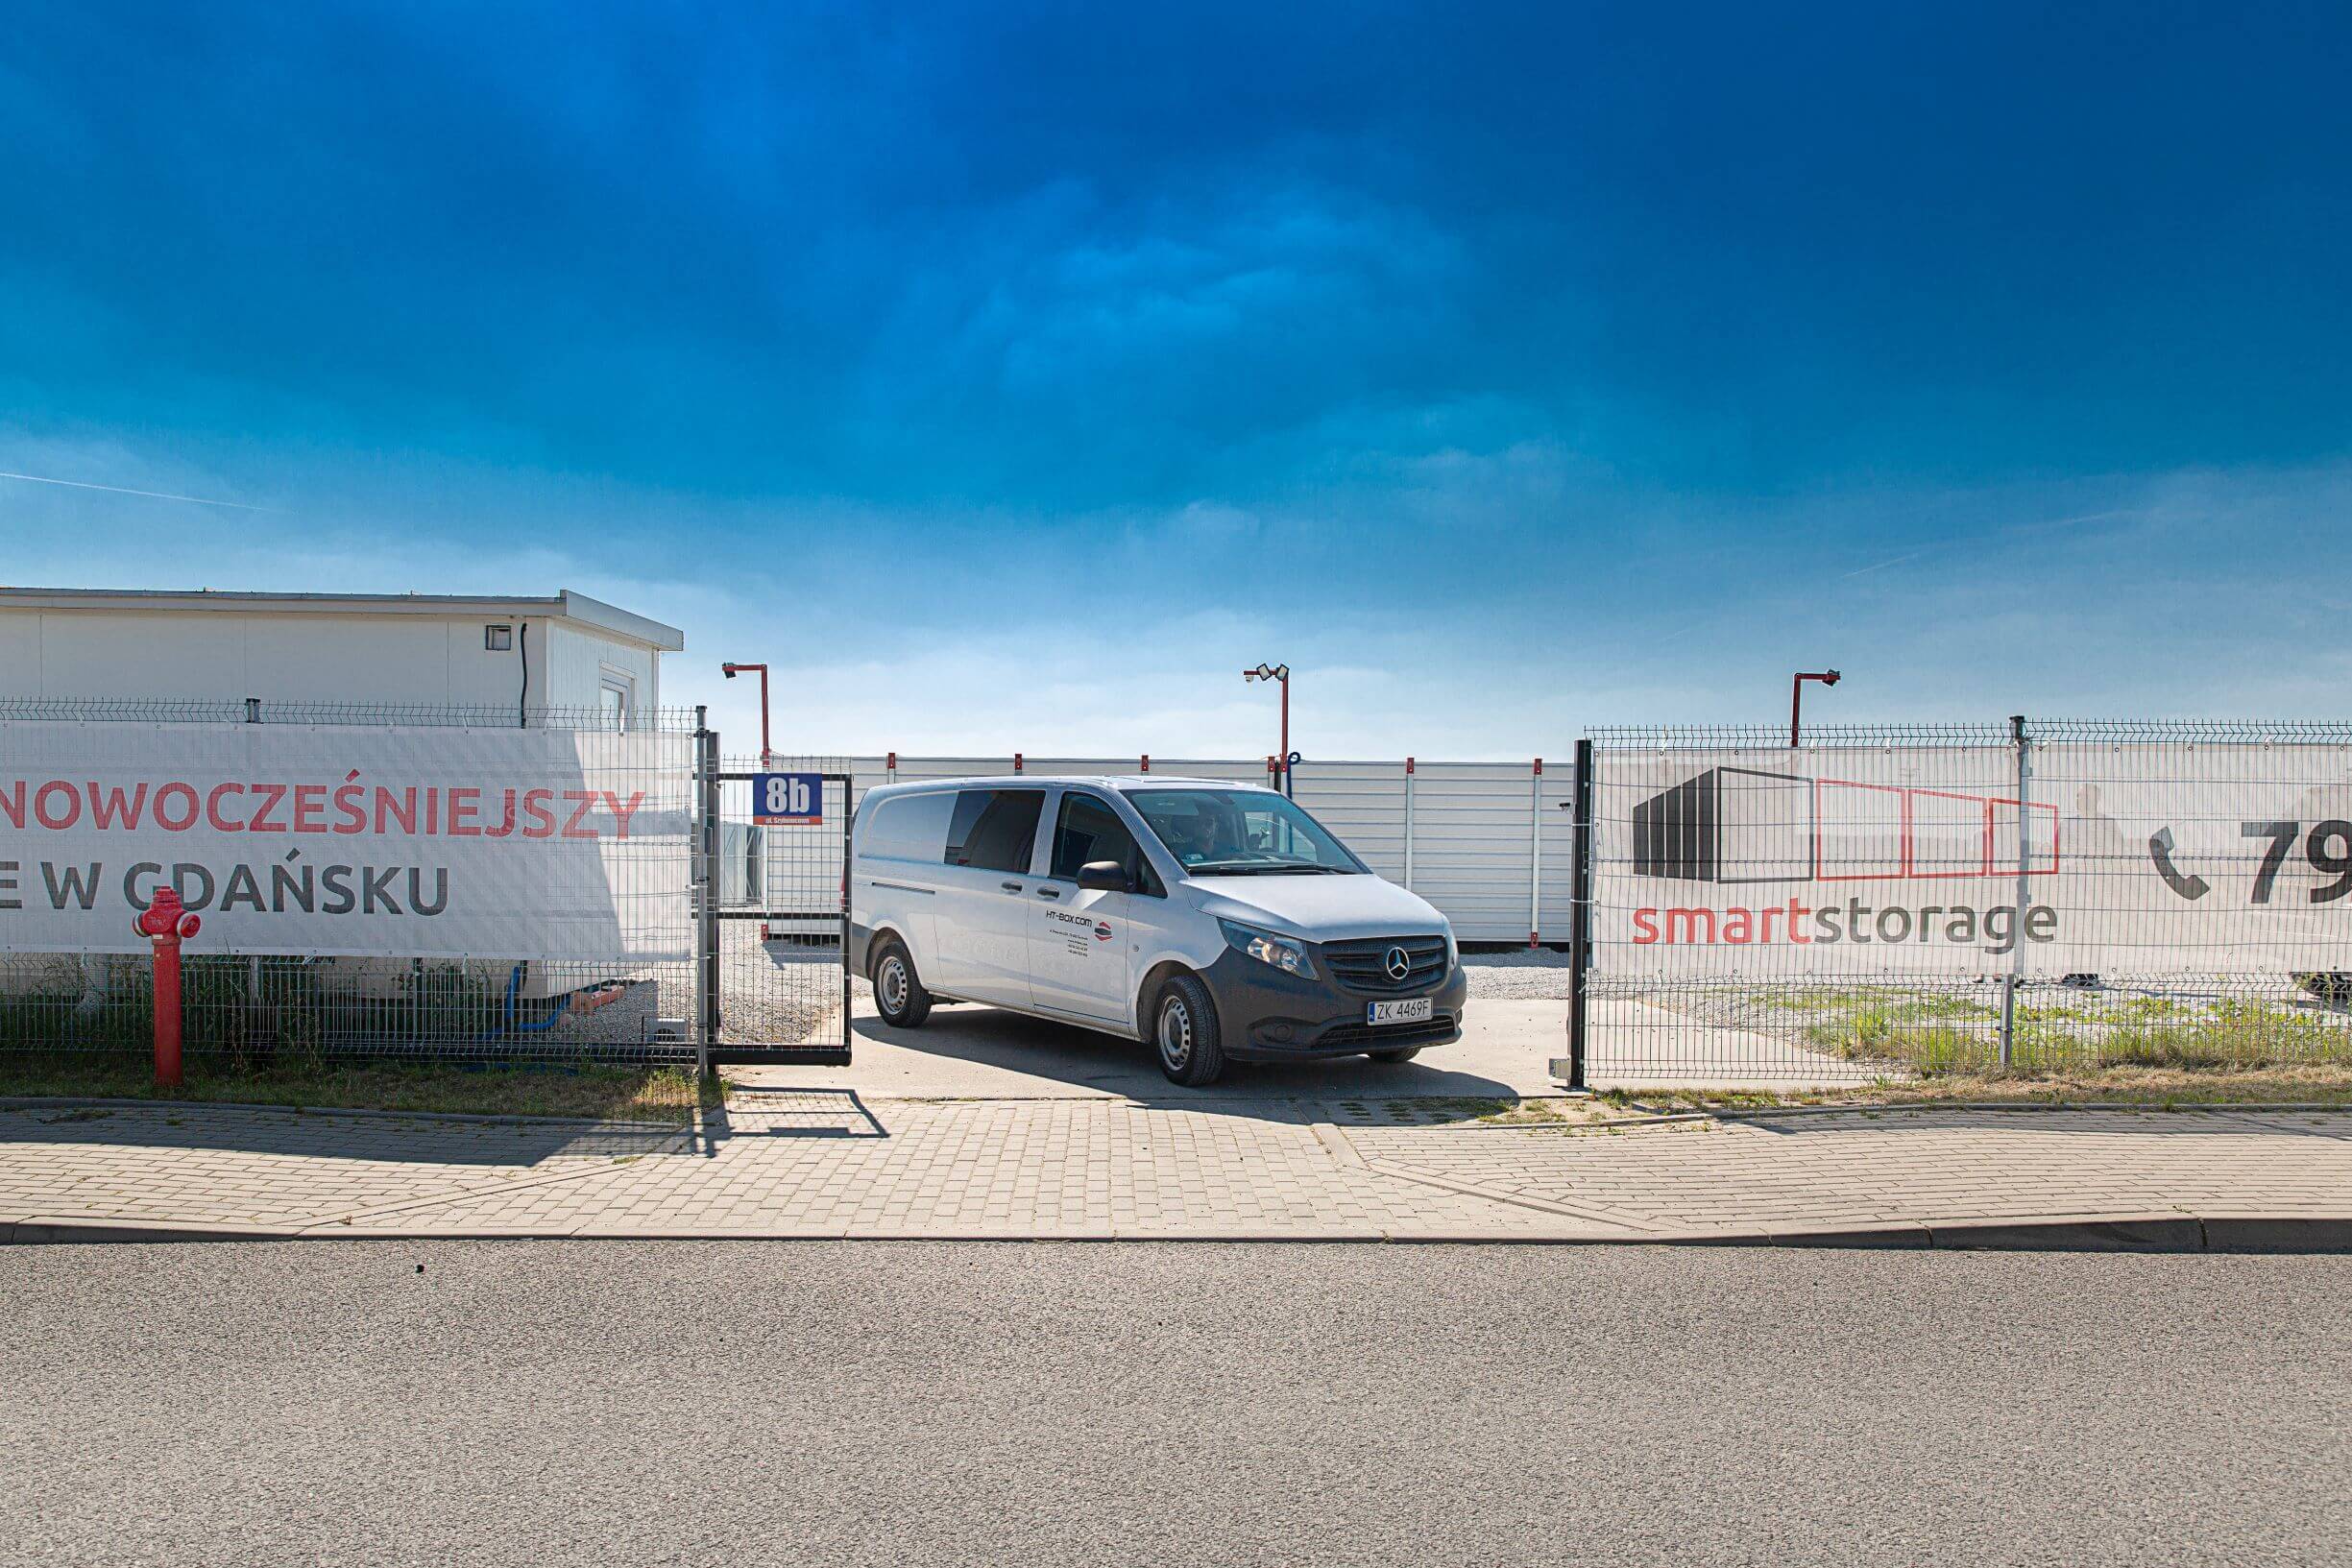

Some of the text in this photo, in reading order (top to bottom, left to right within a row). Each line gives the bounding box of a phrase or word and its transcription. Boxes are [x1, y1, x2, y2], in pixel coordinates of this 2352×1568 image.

[0, 768, 646, 840] NOWOCZEŚNIEJSZY
[766, 777, 810, 813] 8b
[40, 861, 103, 910] W
[123, 847, 449, 916] GDAŃSKU
[2241, 819, 2352, 904] 79
[1632, 897, 2058, 954] smartstorage
[1377, 1001, 1429, 1020] ZK 4469F
